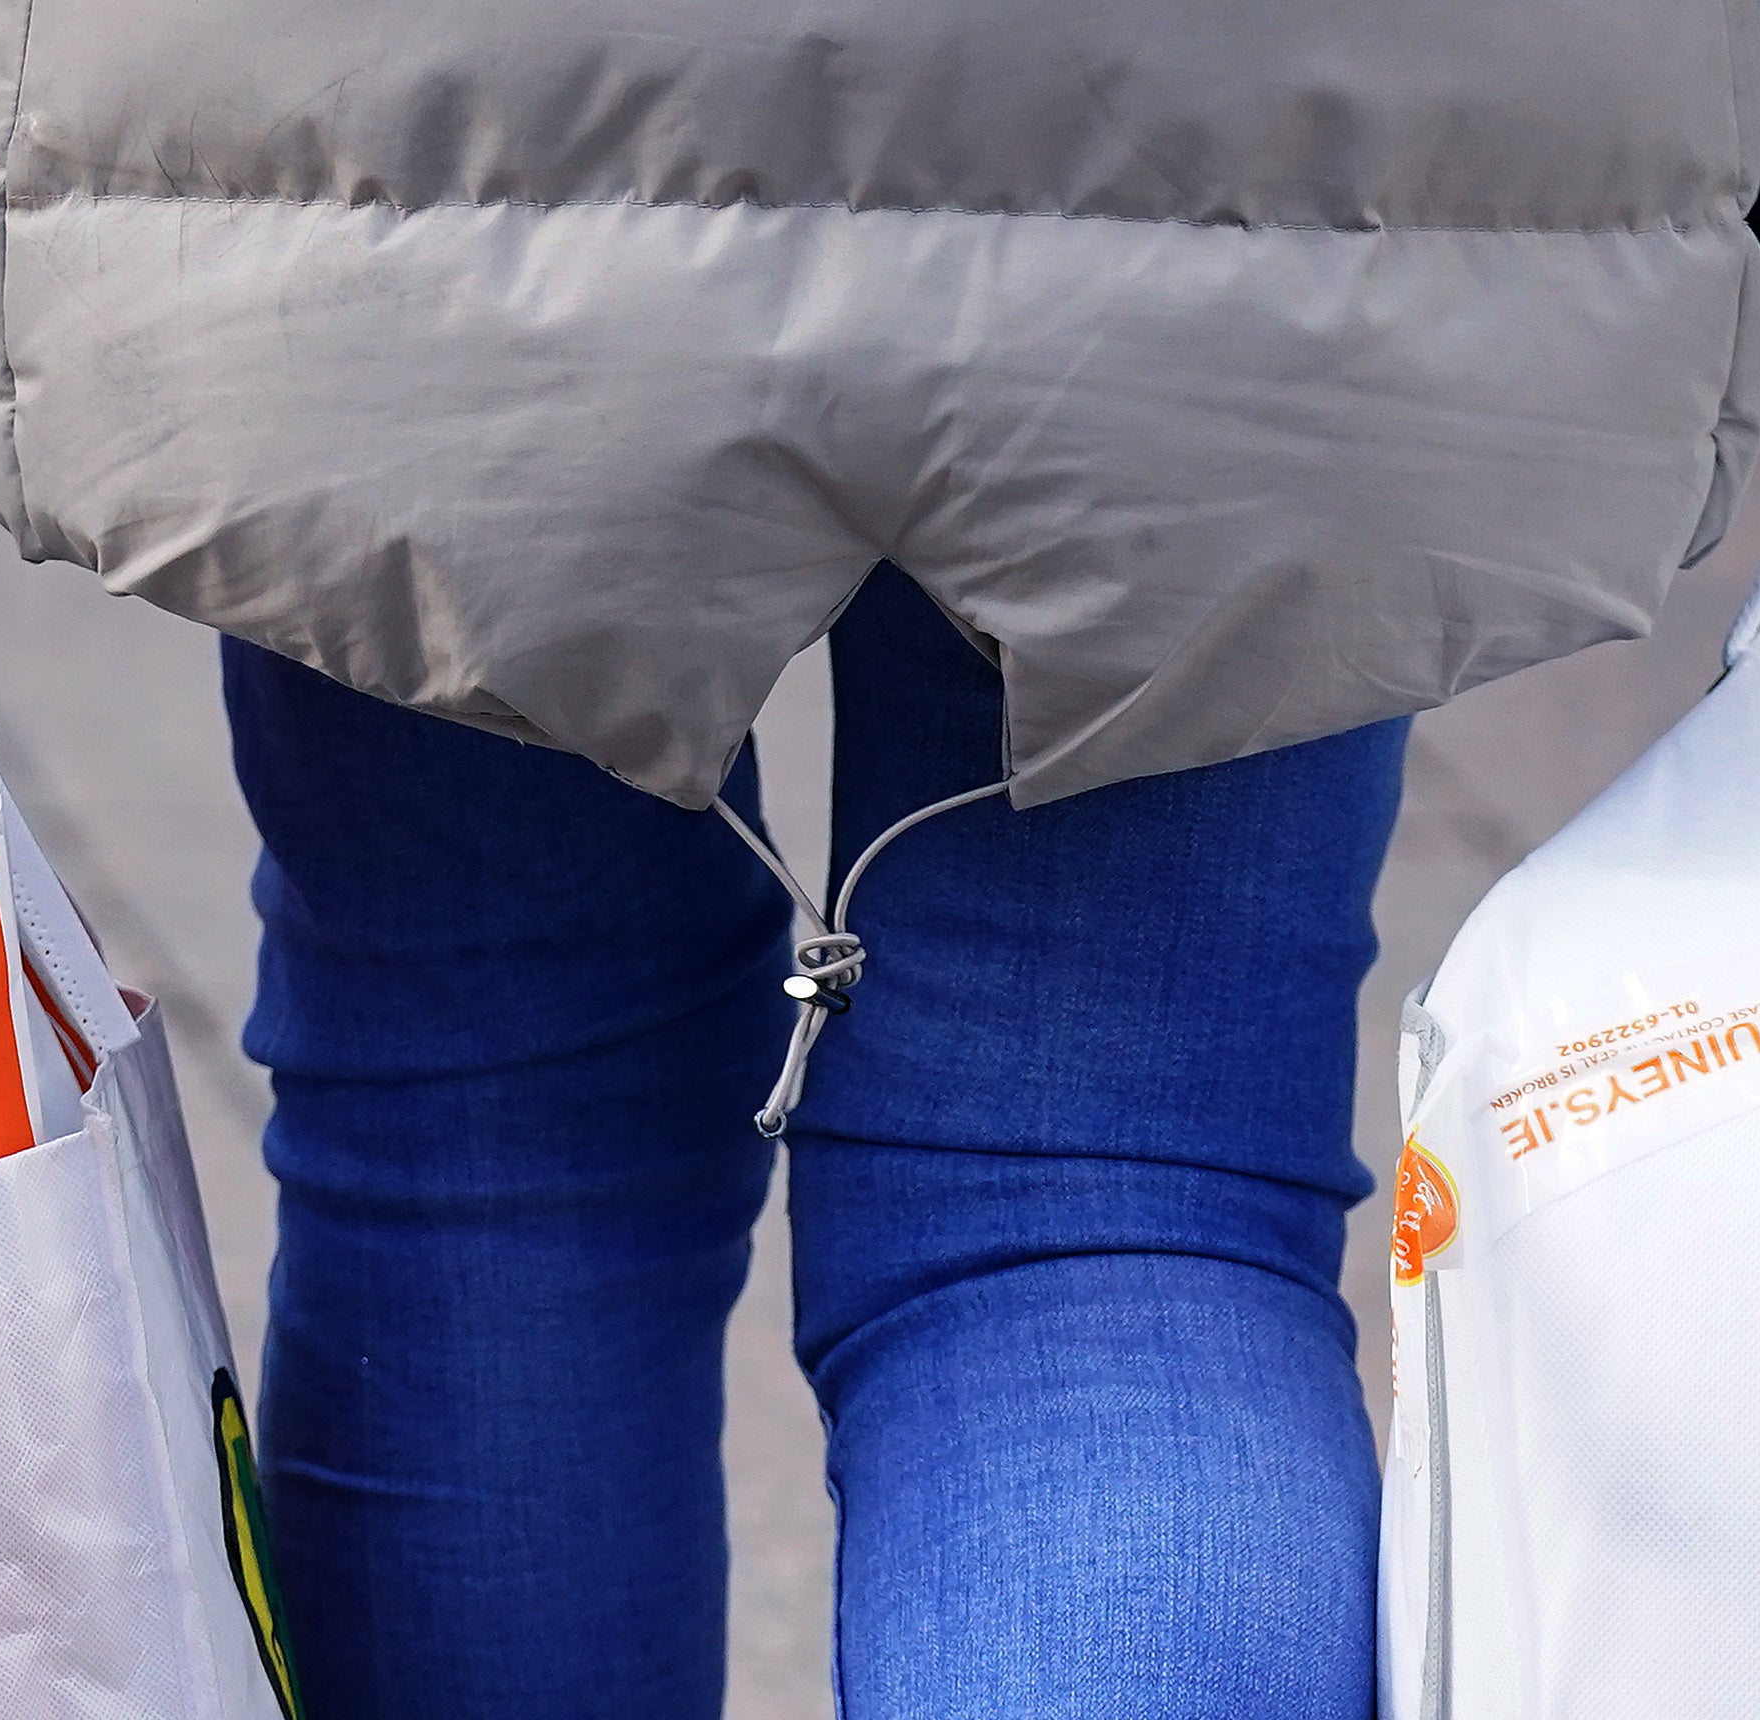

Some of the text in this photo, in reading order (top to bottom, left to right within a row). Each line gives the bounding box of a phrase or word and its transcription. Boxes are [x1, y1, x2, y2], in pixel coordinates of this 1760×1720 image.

[1556, 1000, 1700, 1058] 01-6522902
[1560, 1063, 1578, 1080] IS
[1489, 1072, 1559, 1113] BROKEN
